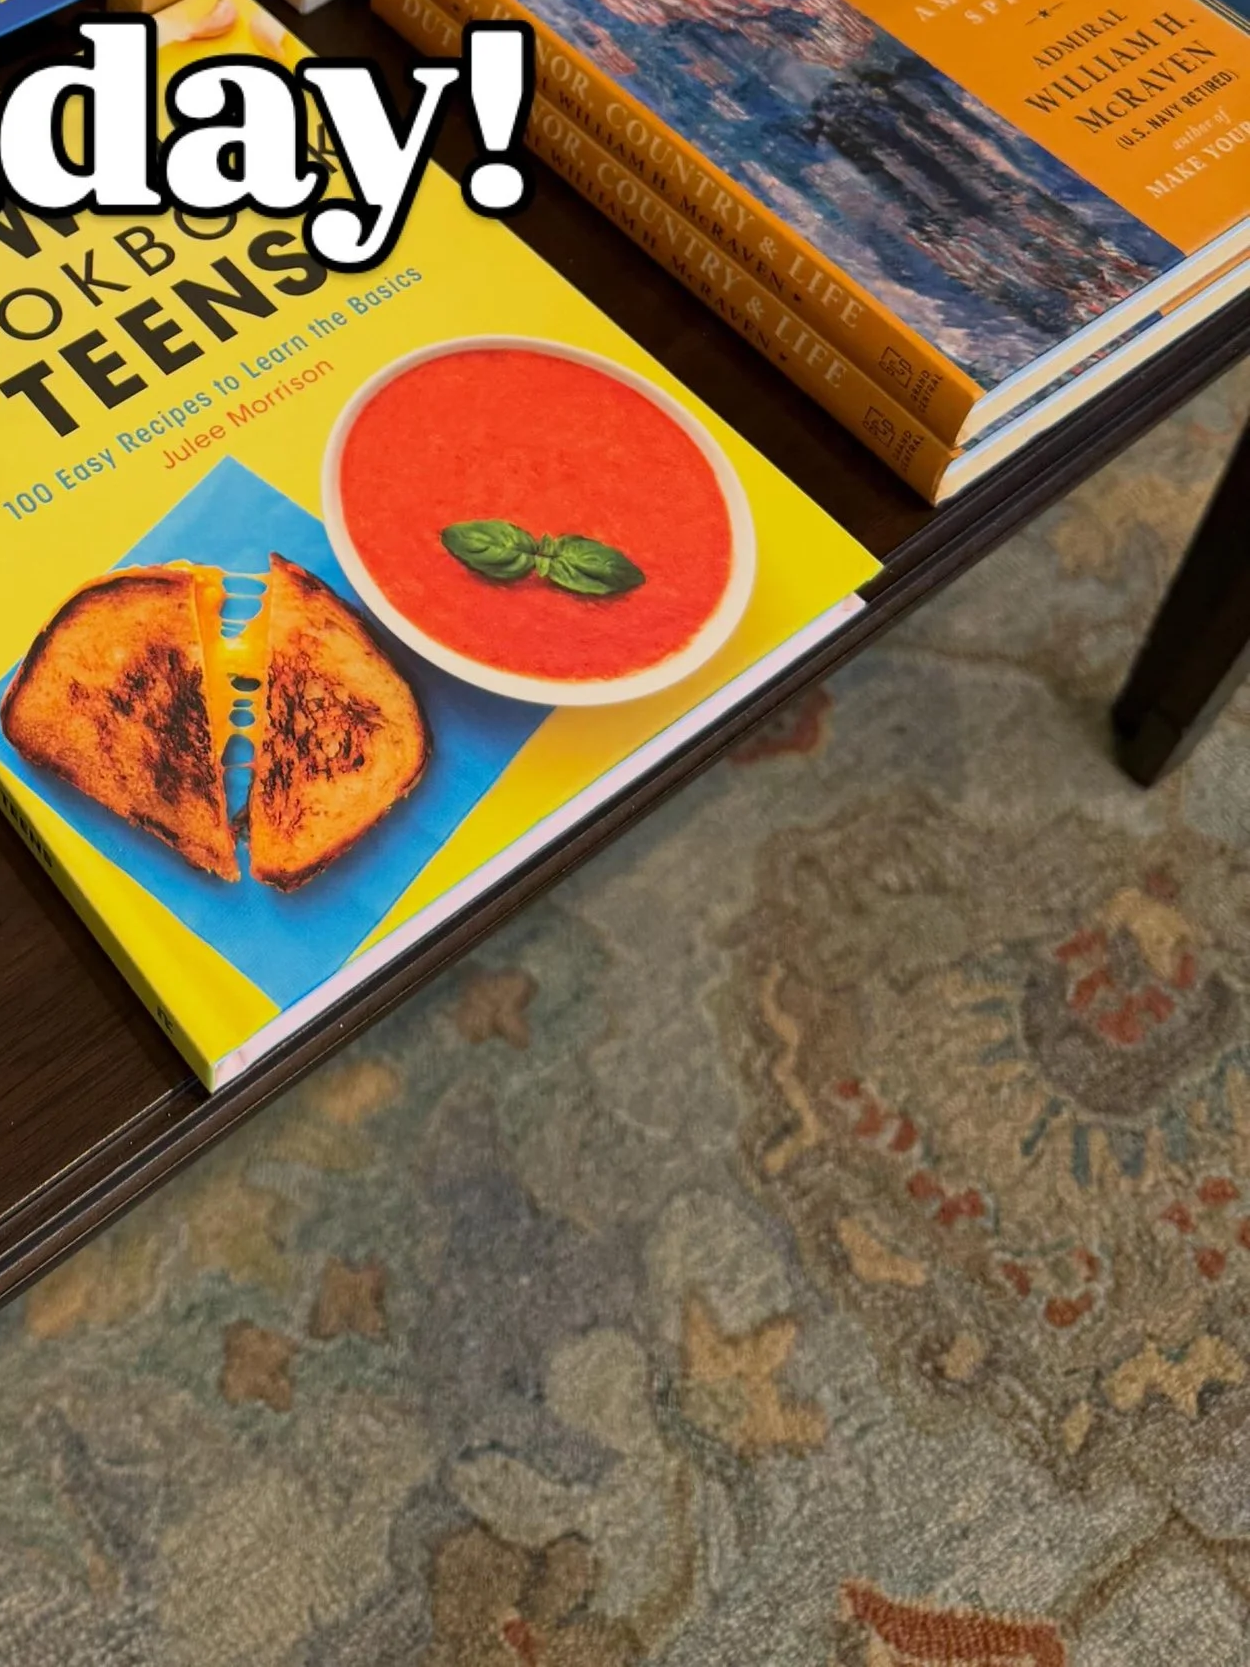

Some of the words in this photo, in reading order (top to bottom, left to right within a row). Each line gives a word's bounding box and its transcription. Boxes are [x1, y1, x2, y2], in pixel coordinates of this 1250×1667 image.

[1024, 28, 1162, 114] WILLIAM
[1153, 11, 1198, 37] H.
[1031, 8, 1128, 71] ADMIRAL
[1073, 39, 1218, 134] McRAVEN
[558, 90, 646, 175] WILLIAM
[1145, 102, 1183, 131] NAVY
[1180, 69, 1240, 108] RETIRED)
[1172, 117, 1214, 151] author
[605, 100, 755, 230] COUNTRY
[757, 235, 781, 260] &
[786, 258, 866, 329] LIFE
[1145, 155, 1208, 200] MAKE
[596, 161, 743, 293] COUNTRY
[744, 294, 766, 320] &
[771, 313, 851, 390] LIFE
[1, 481, 54, 521] 100
[55, 443, 117, 495] Easy
[115, 388, 214, 455] Recipes
[211, 371, 242, 398] to
[240, 335, 308, 381] Learn
[306, 306, 349, 339] the
[346, 264, 424, 317] Basics
[162, 421, 228, 470] Julee
[225, 359, 336, 429] Morrison
